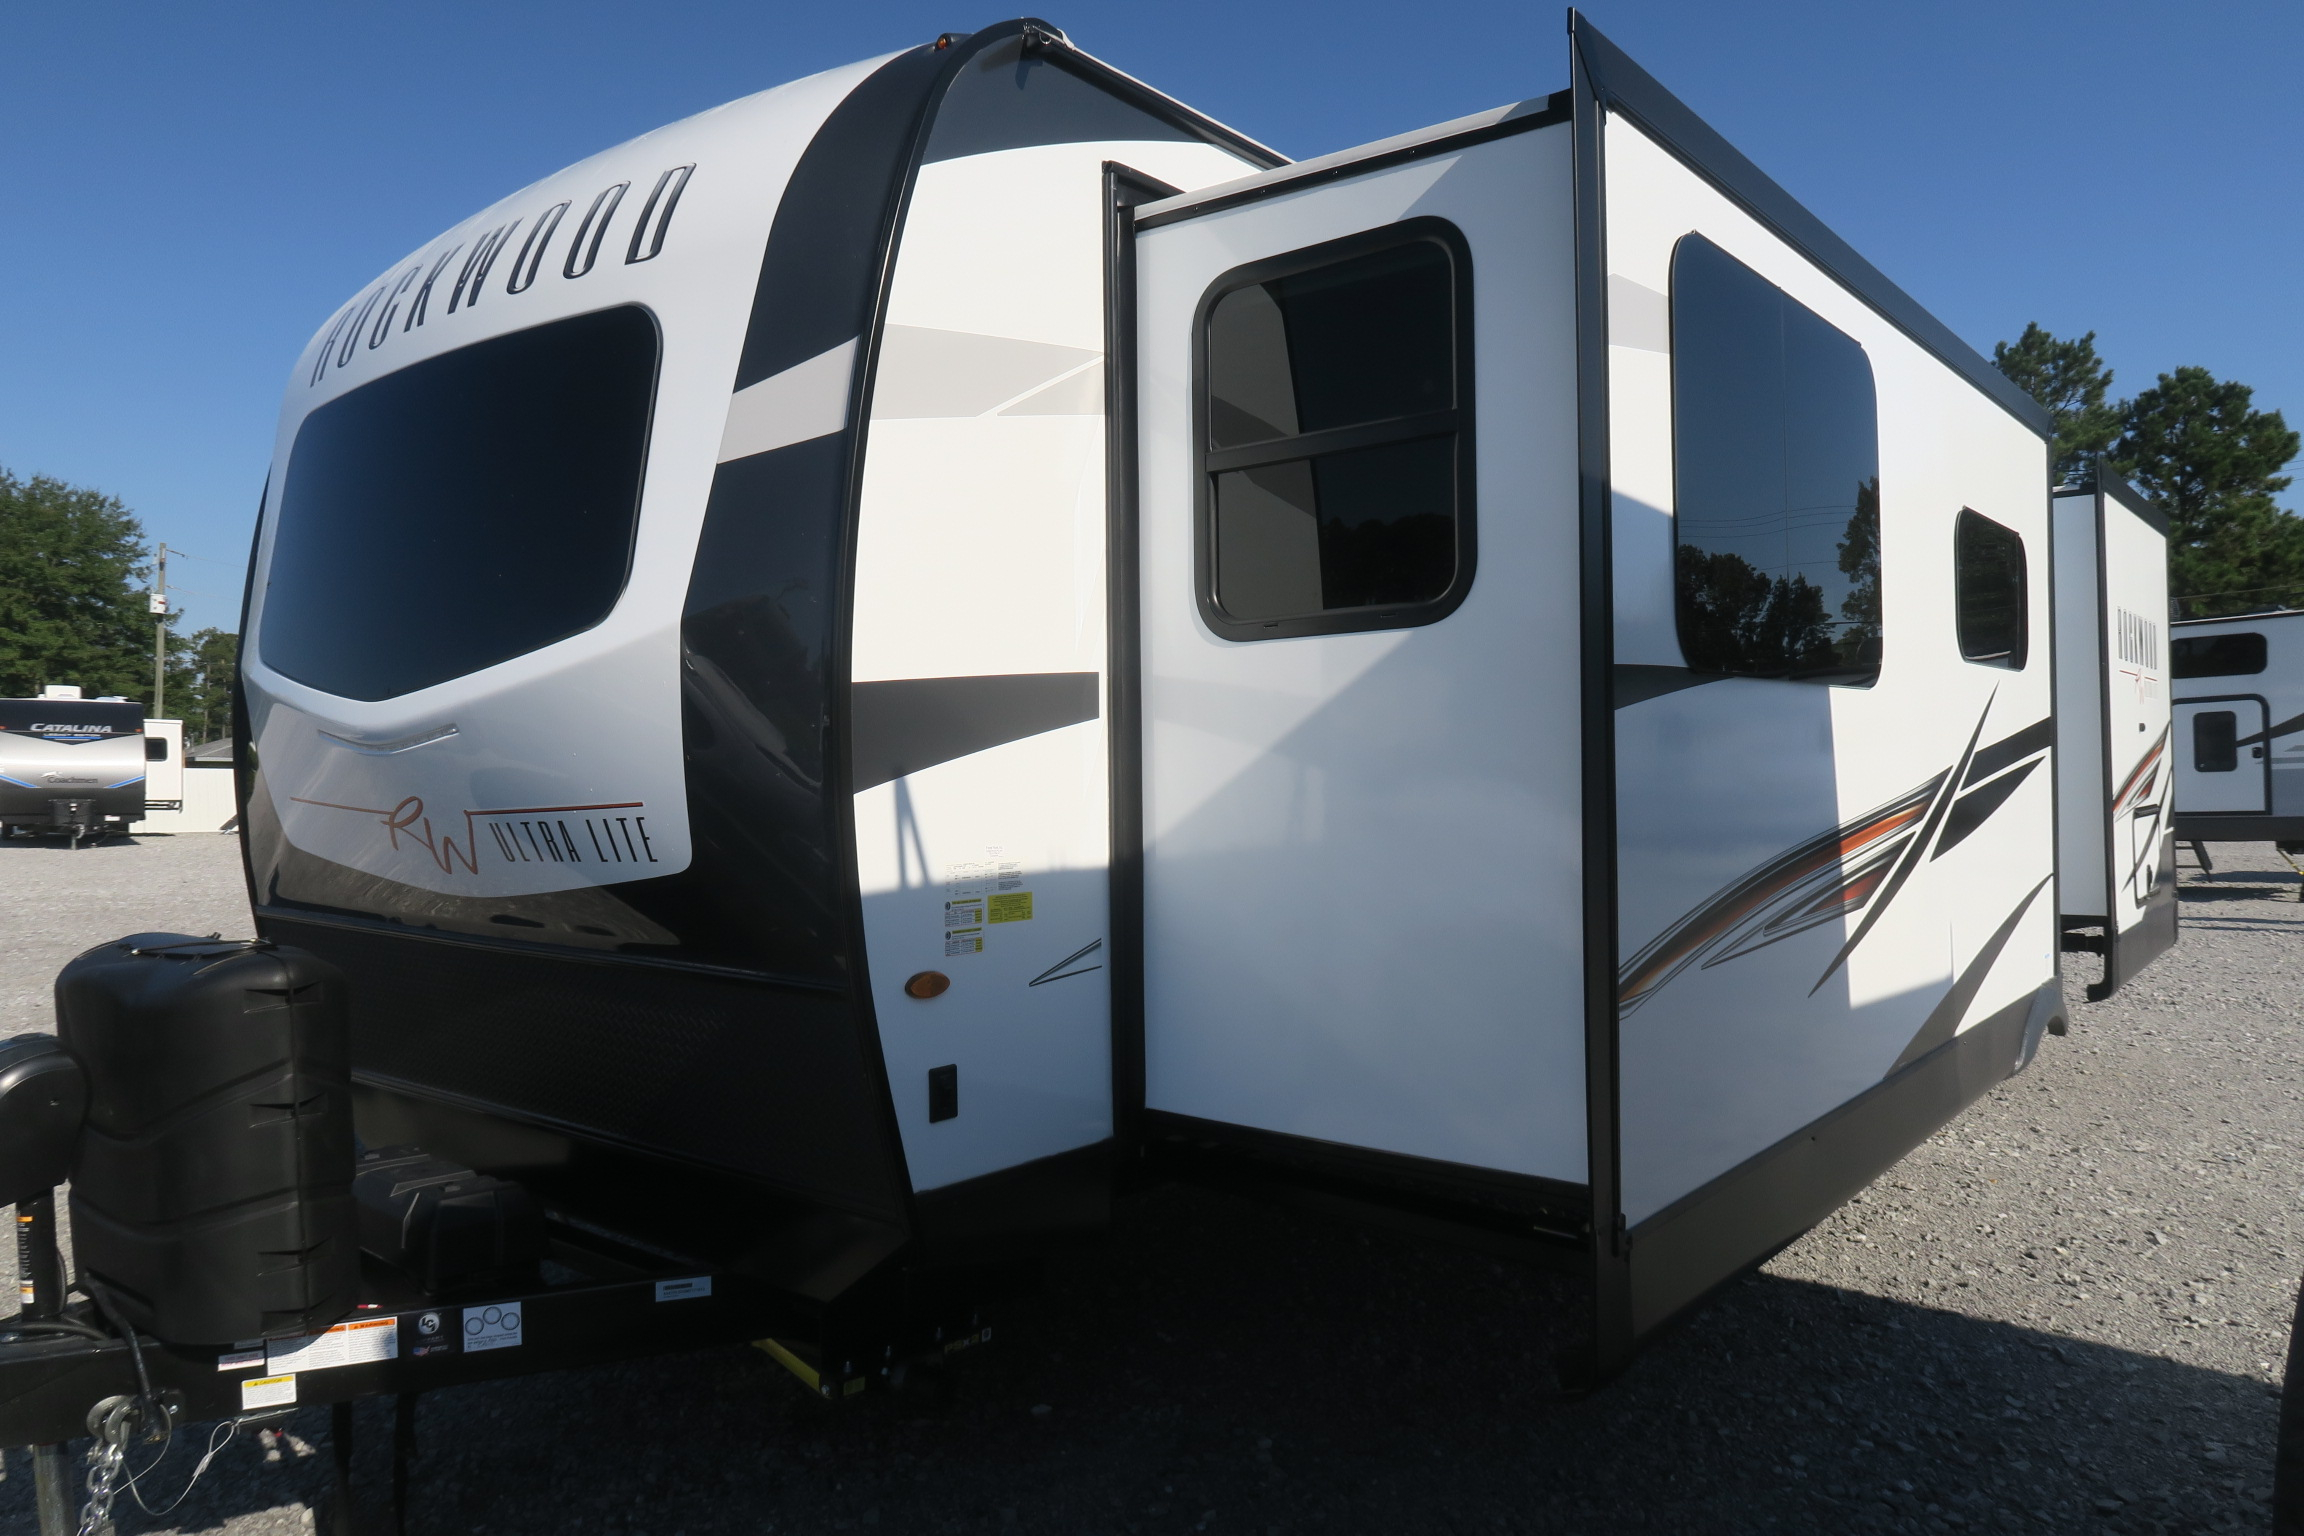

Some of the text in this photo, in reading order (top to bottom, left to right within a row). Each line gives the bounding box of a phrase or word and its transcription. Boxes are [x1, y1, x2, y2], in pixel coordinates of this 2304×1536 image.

[310, 162, 698, 388] ROCKWOOD
[30, 723, 112, 733] CATALINA
[489, 820, 581, 863] ULTRA
[585, 816, 658, 863] LITE
